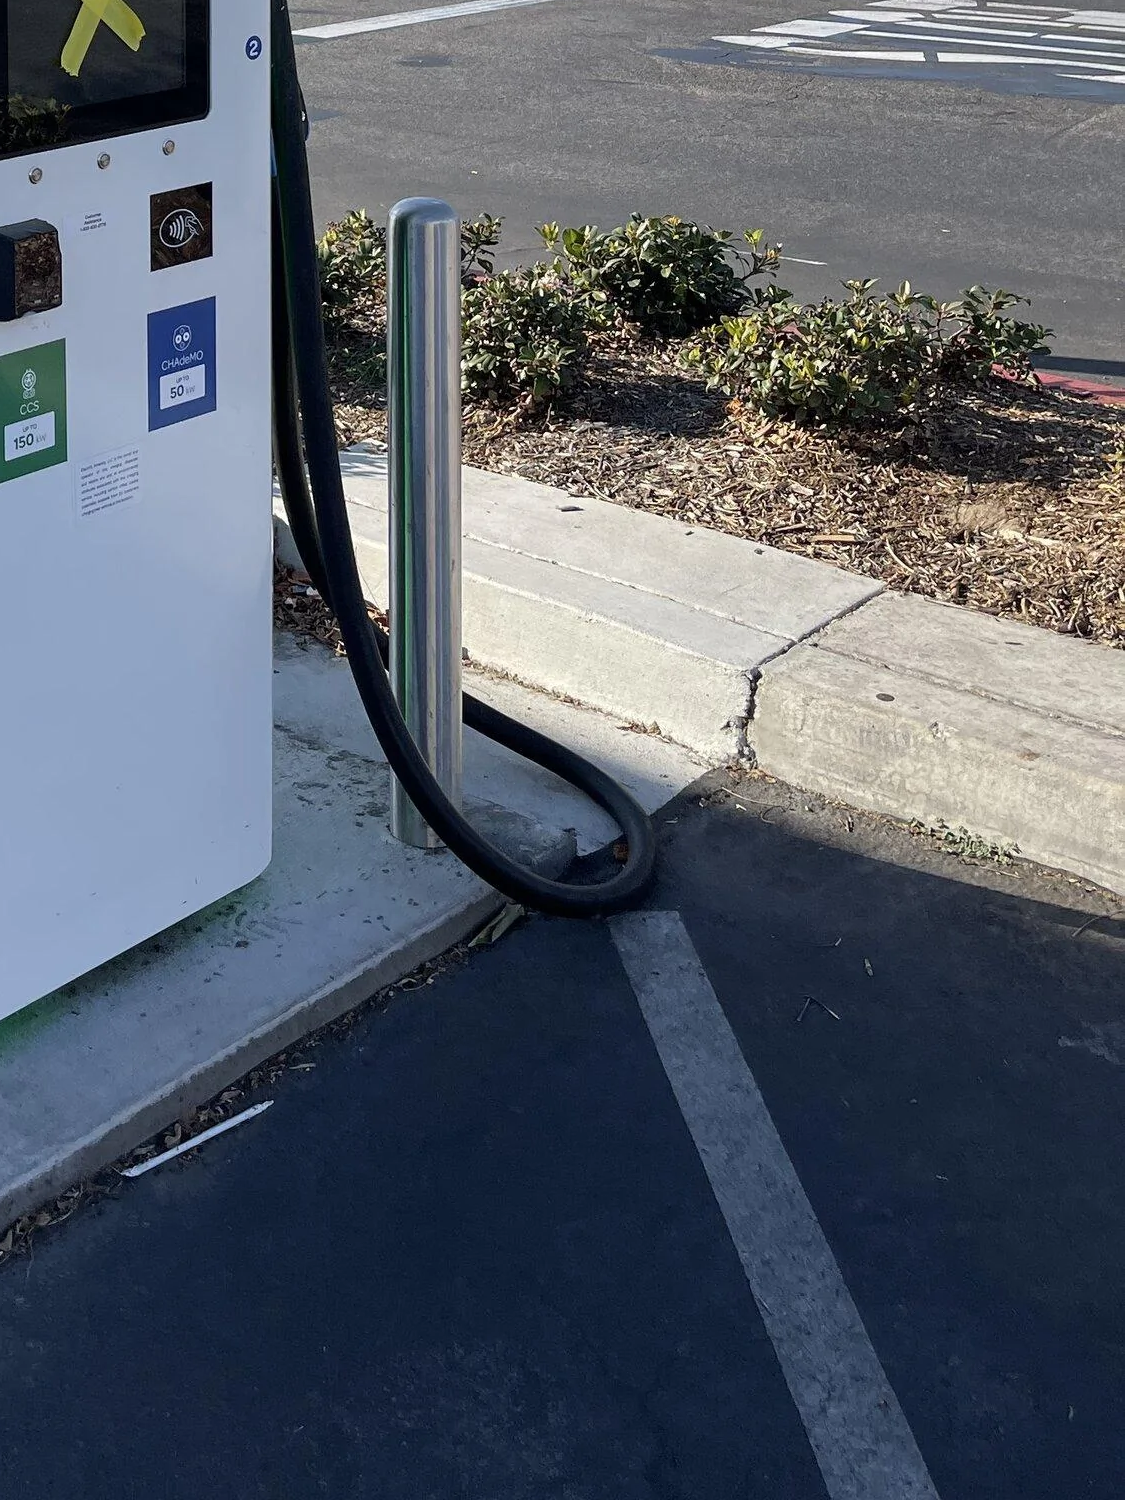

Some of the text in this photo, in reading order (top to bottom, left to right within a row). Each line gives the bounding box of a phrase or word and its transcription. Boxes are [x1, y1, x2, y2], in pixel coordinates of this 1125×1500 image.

[161, 350, 204, 371] CHAdeMO
[170, 384, 184, 399] 50
[19, 400, 40, 415] CCS
[13, 433, 34, 450] 150
